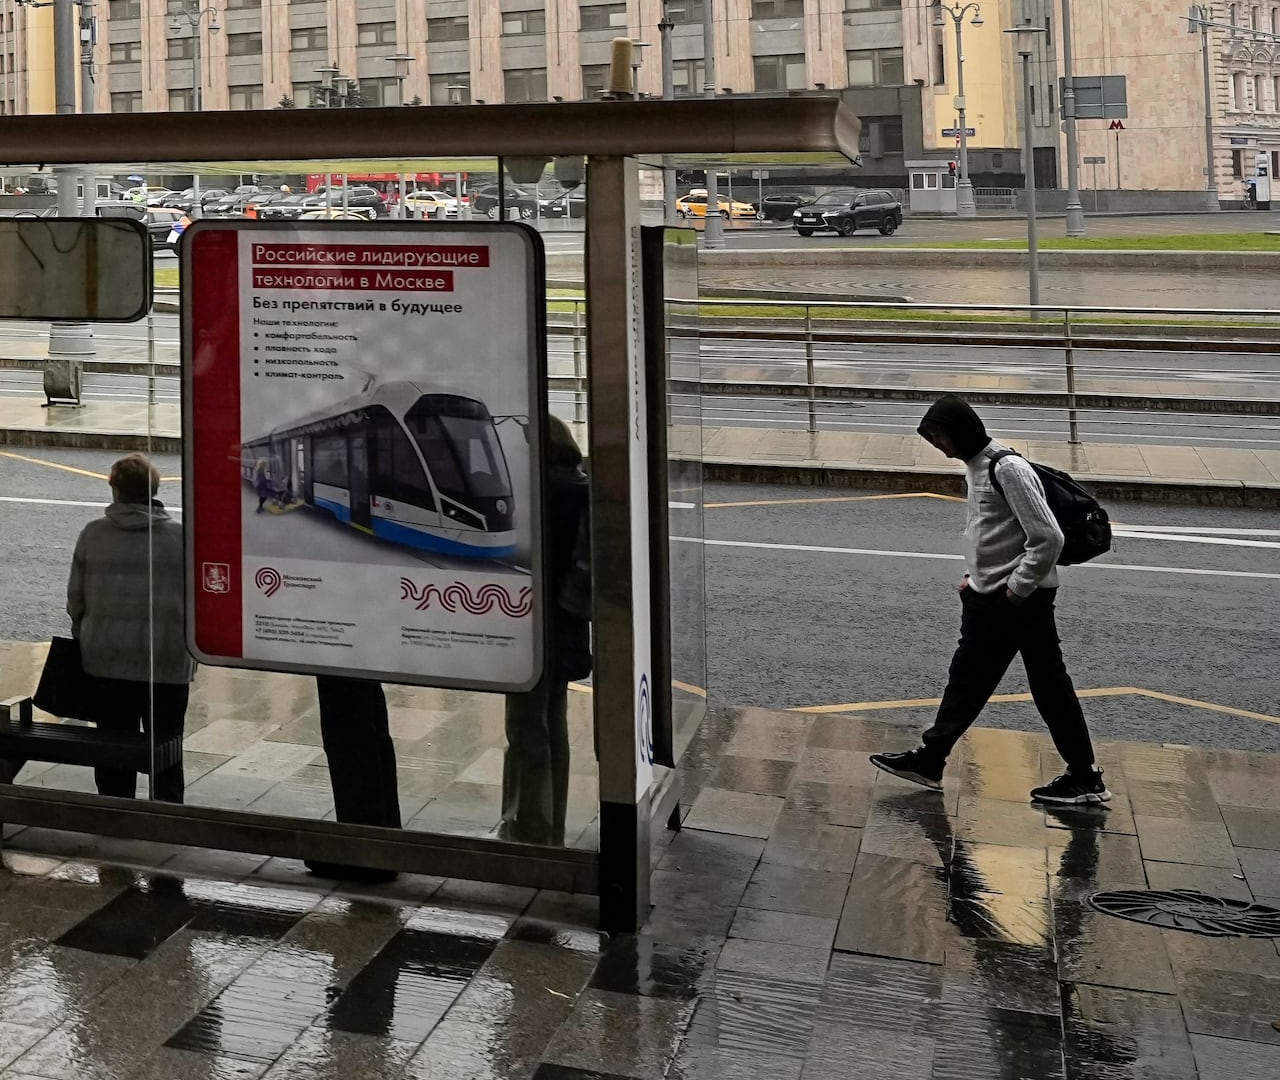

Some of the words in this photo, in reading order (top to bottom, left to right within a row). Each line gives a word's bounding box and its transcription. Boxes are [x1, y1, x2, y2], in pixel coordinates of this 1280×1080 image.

[255, 245, 357, 262] Российские
[361, 249, 480, 266] лидирующие
[255, 274, 355, 288] технологии
[361, 277, 368, 287] в
[375, 273, 446, 289] Москве
[253, 297, 278, 309] Без
[282, 300, 374, 313] препятствий
[379, 303, 386, 311] в
[391, 299, 463, 315] будущее
[253, 318, 280, 326] Наши
[282, 320, 339, 328] технологии:
[265, 332, 358, 341] комфортабельность
[265, 372, 344, 381] климат-контроль
